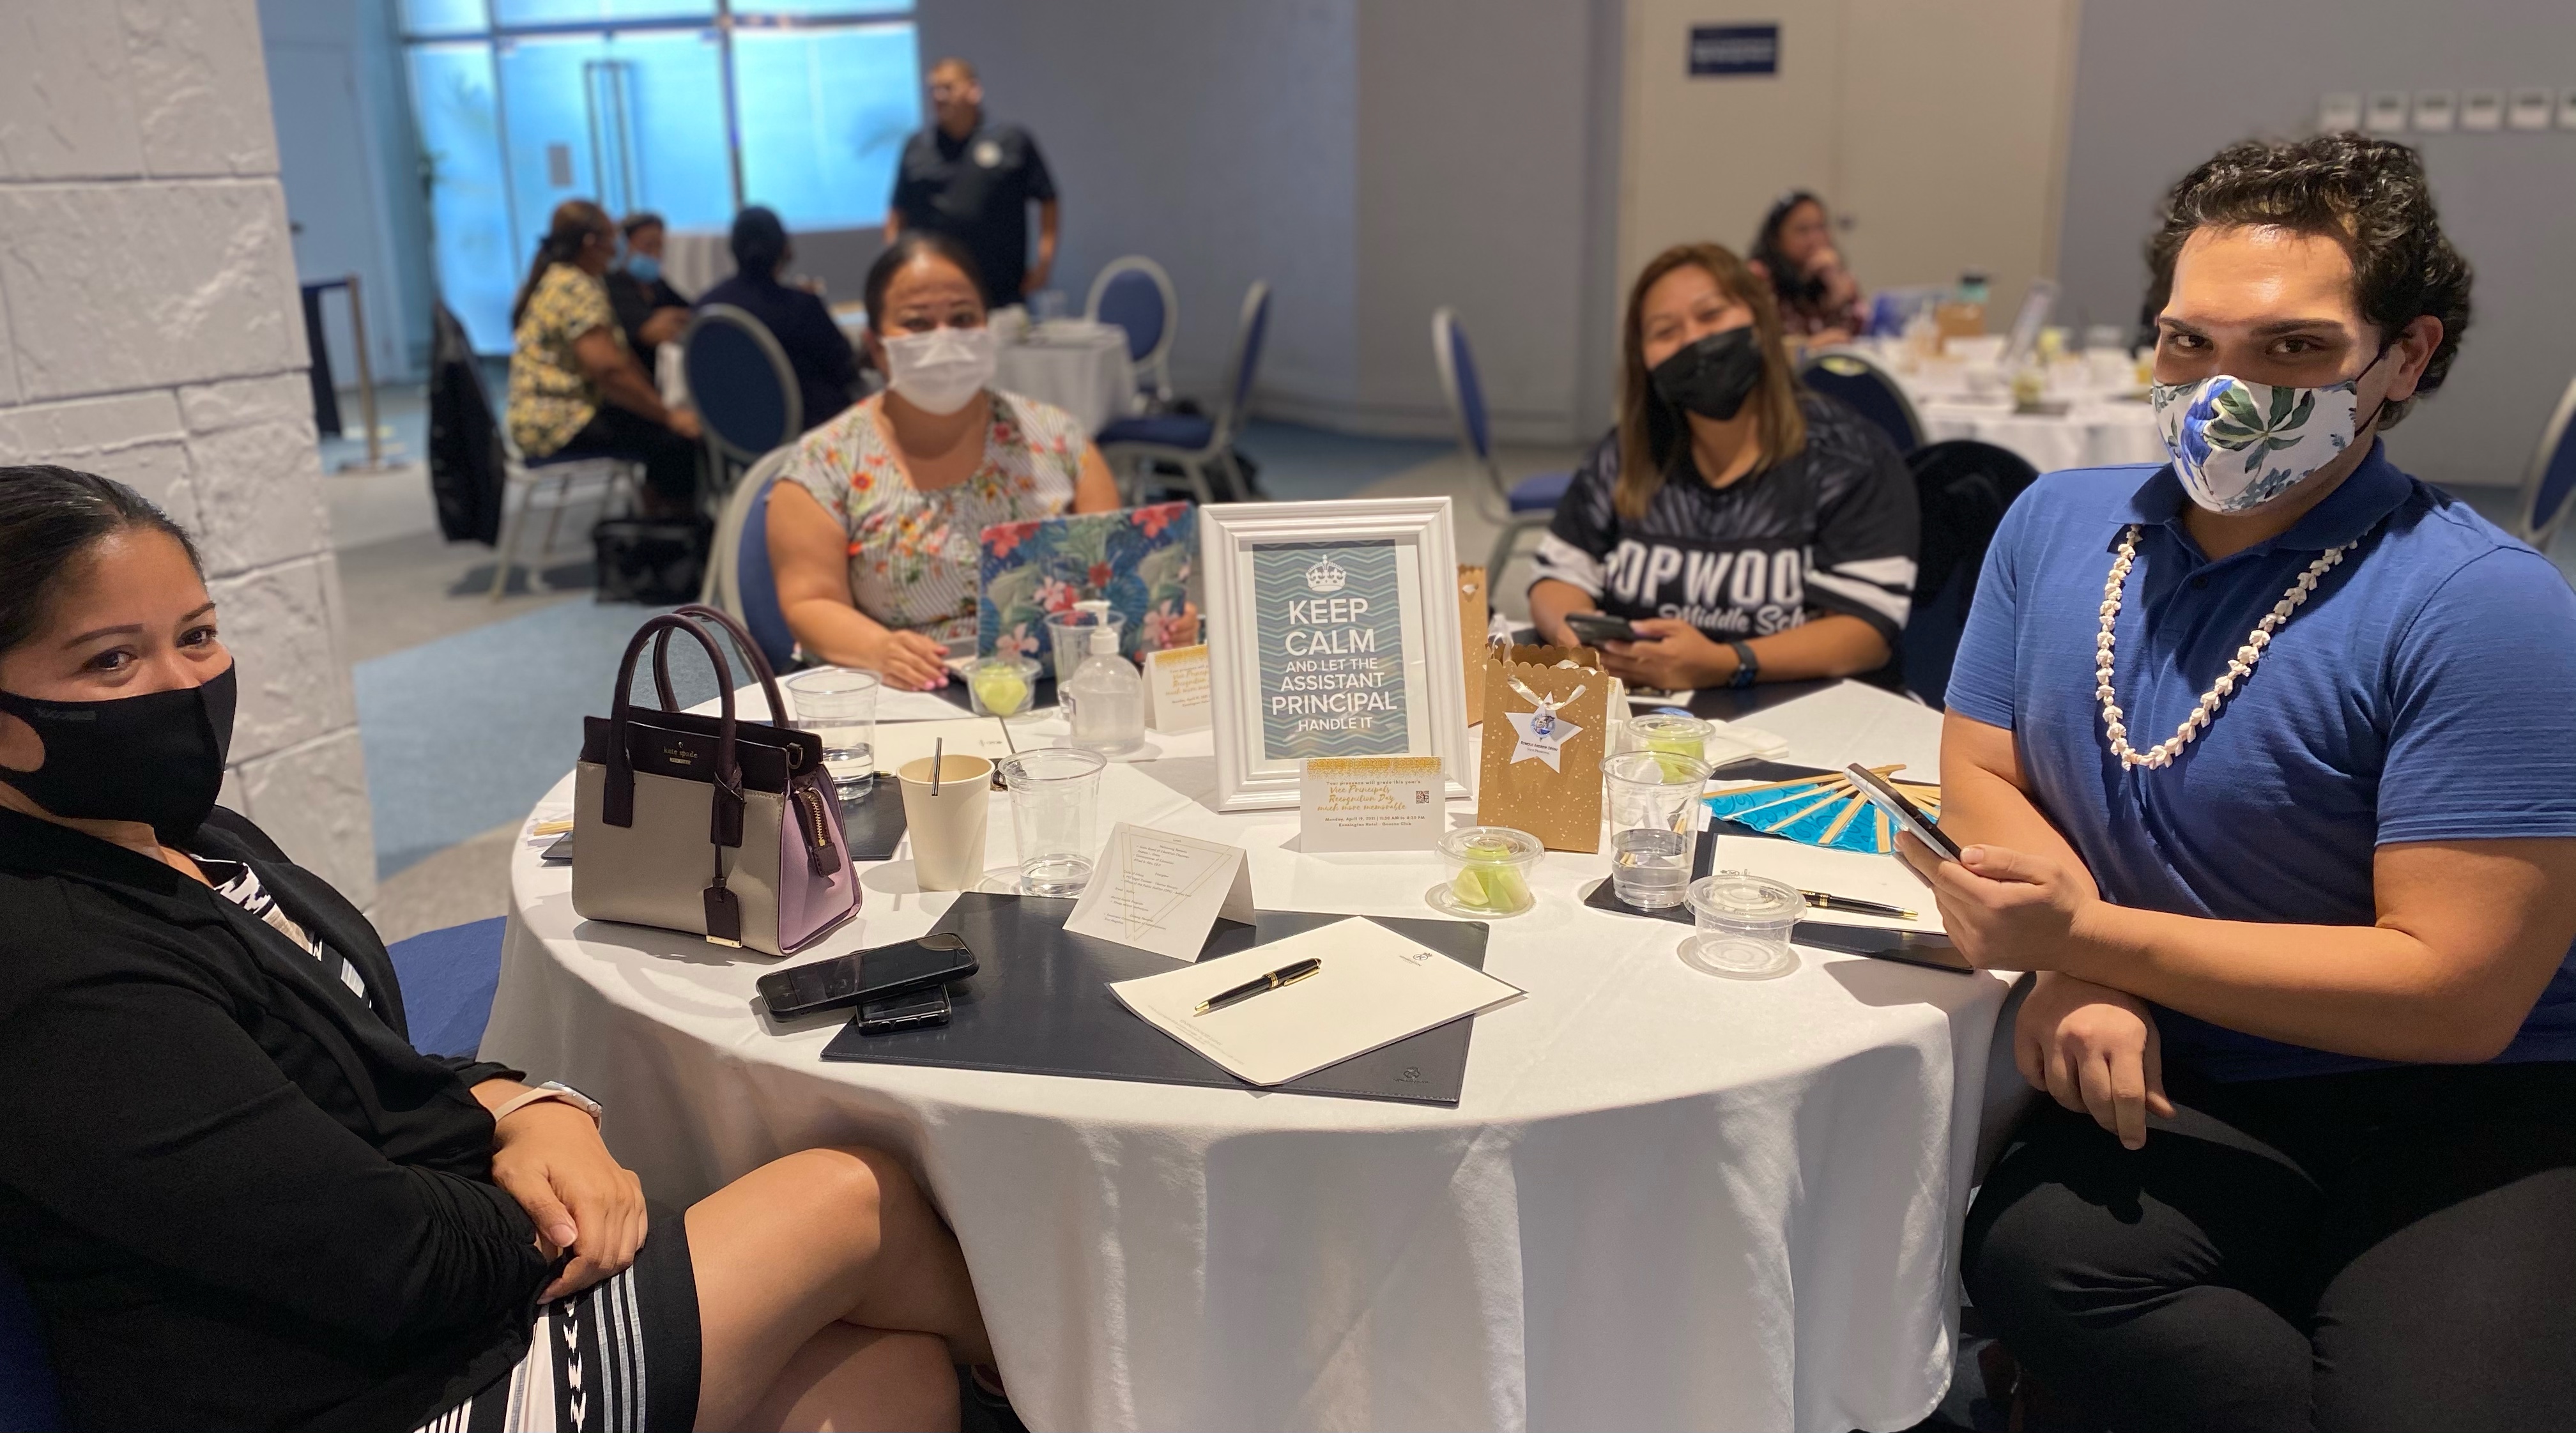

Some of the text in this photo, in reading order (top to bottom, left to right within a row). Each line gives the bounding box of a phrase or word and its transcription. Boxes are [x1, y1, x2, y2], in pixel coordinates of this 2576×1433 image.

[1606, 539, 1813, 607] OPWOO
[1289, 598, 1368, 625] KEEP
[1754, 606, 1809, 636] Sch
[1285, 628, 1375, 656] CALM
[1285, 657, 1378, 673] AND LET THE
[1280, 672, 1384, 691] ASSISTANT
[1271, 691, 1397, 716] PRINCIPAL
[1298, 717, 1373, 732] HANDLE IT
[664, 746, 677, 755] kate
[1317, 803, 1339, 811] much
[1363, 802, 1406, 811] memorable
[1329, 794, 1395, 805] Recognition Day
